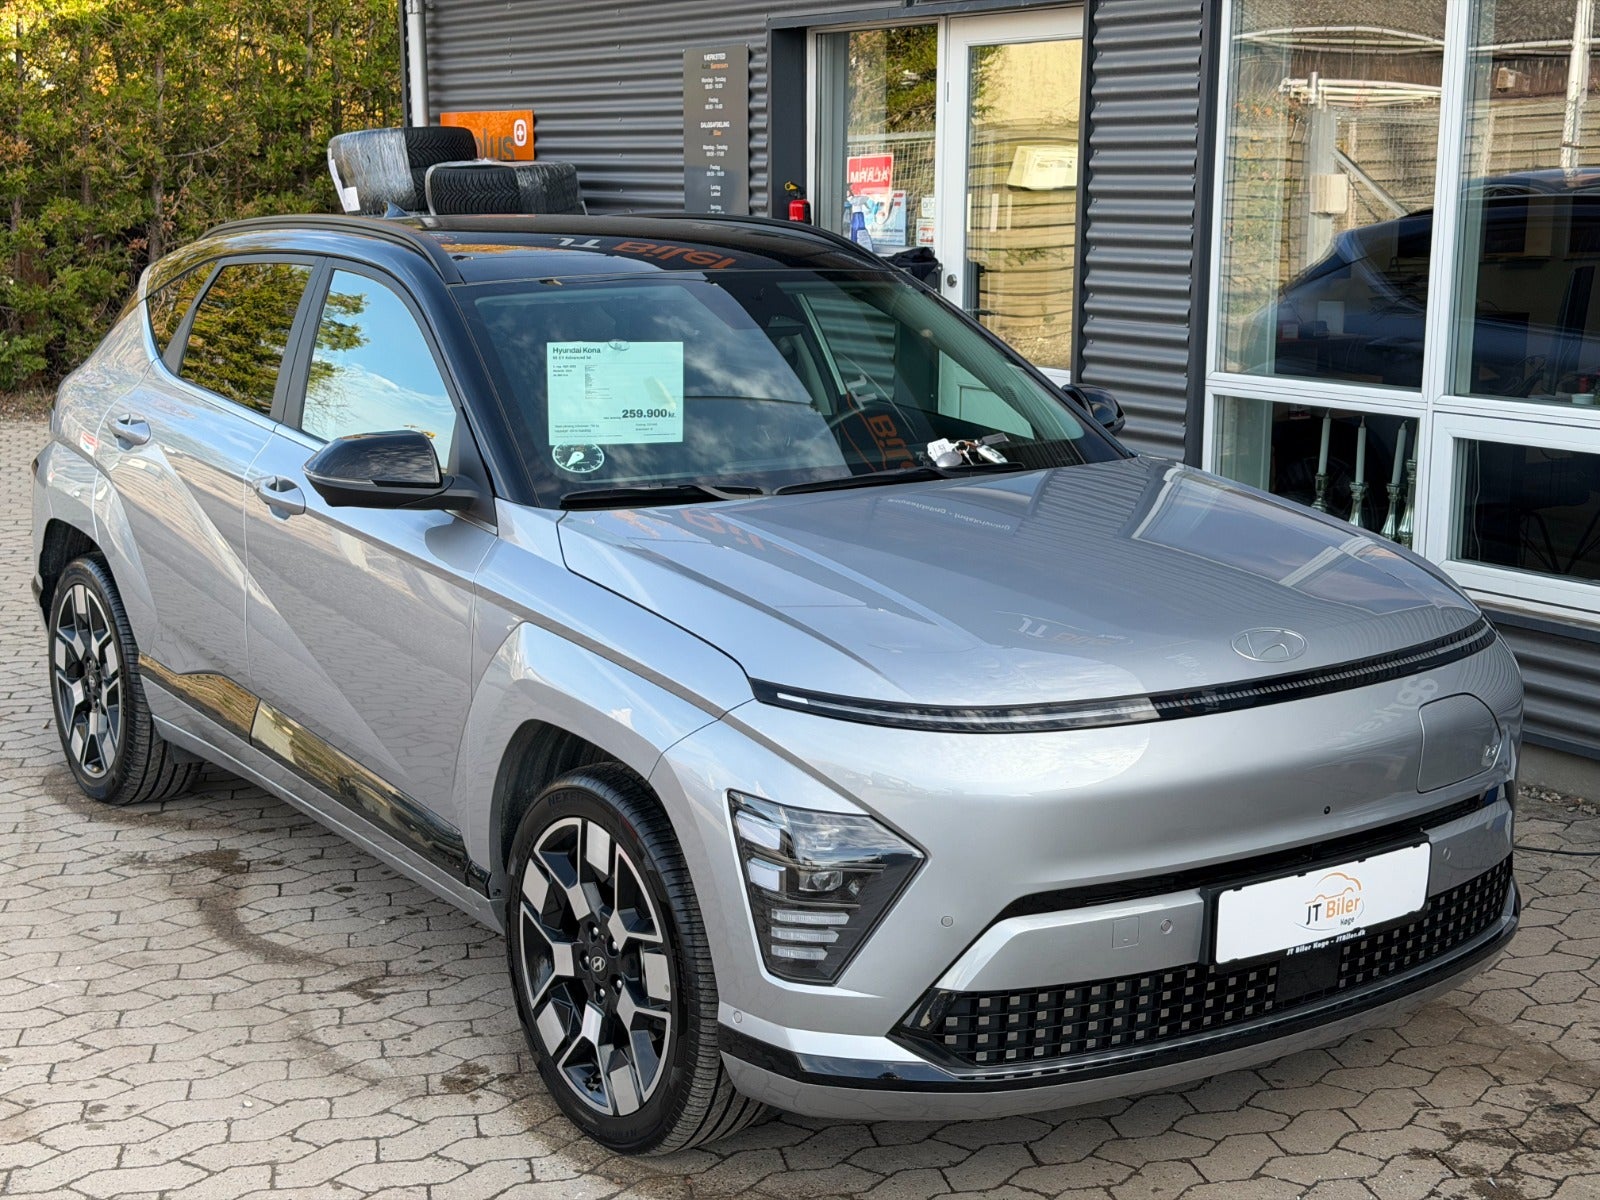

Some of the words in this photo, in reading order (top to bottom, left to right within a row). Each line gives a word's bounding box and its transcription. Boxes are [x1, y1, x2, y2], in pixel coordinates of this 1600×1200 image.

[552, 347, 582, 355] Hyundai
[621, 408, 668, 419] 259.900
[1306, 903, 1322, 926] JT
[1326, 896, 1361, 919] Biler
[1286, 948, 1295, 956] JT
[1295, 944, 1312, 954] Biler
